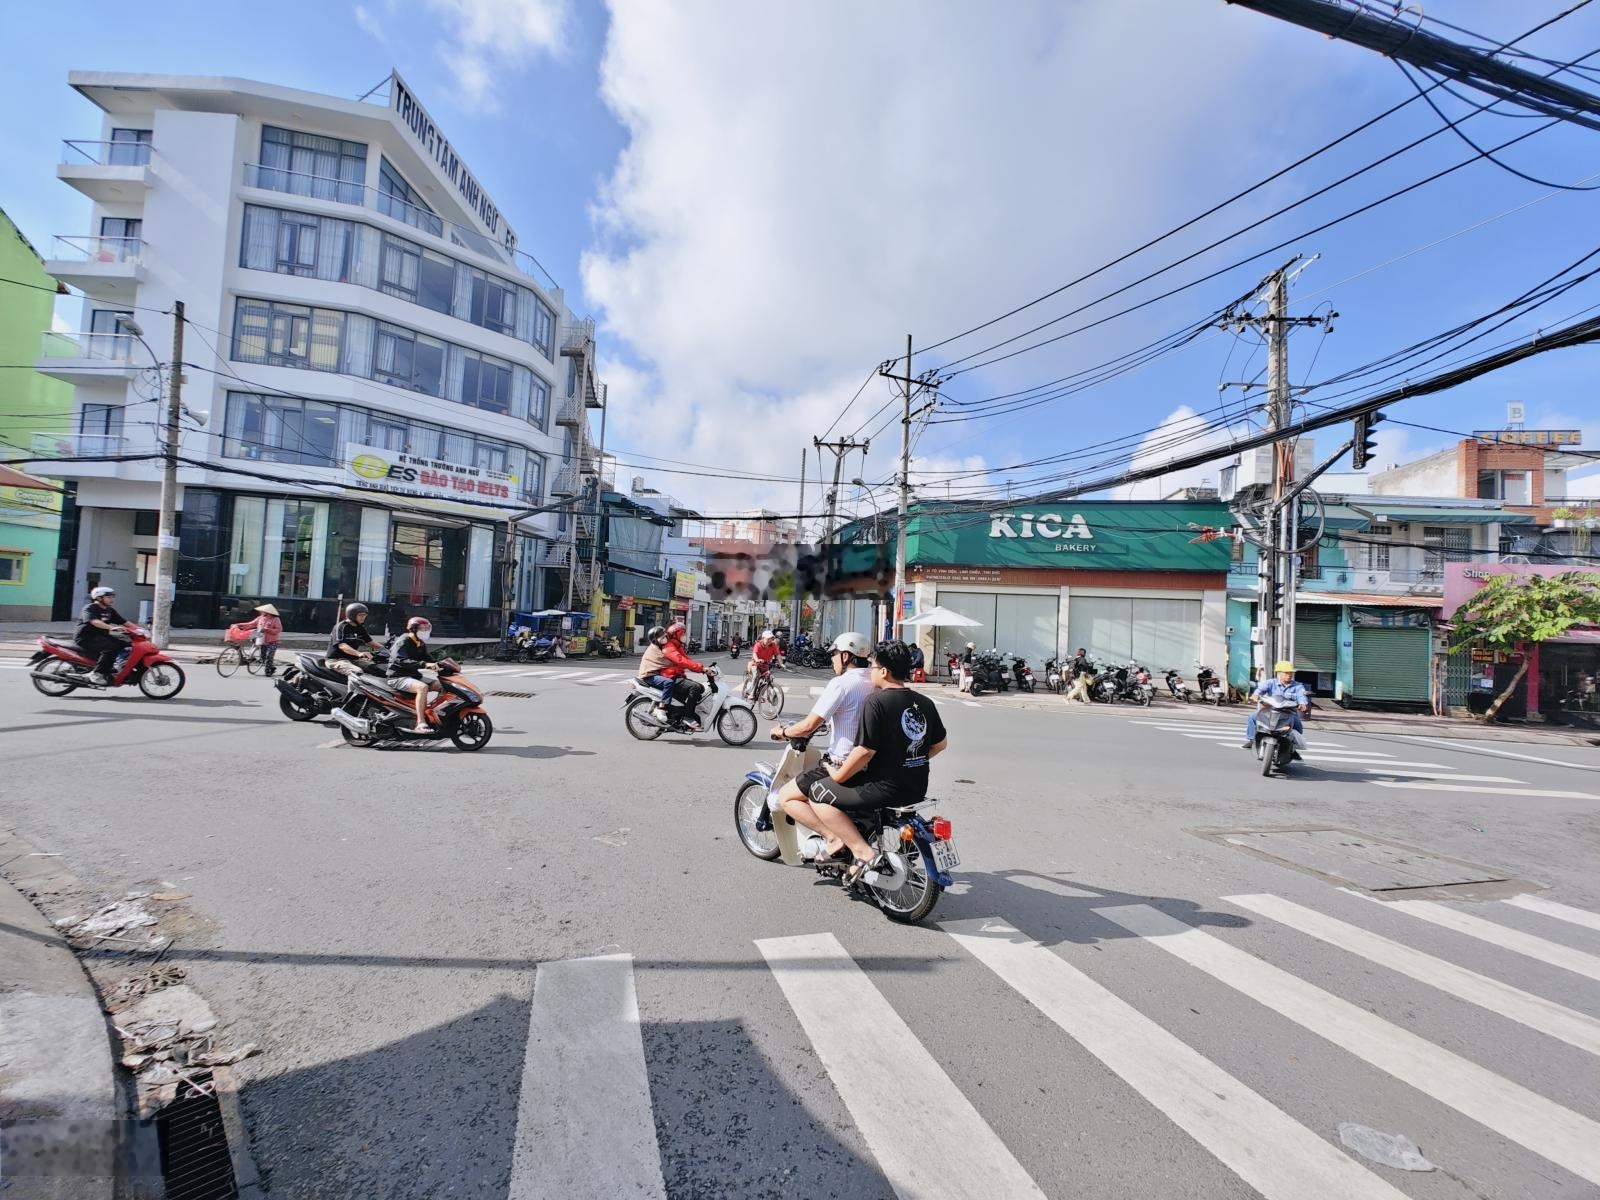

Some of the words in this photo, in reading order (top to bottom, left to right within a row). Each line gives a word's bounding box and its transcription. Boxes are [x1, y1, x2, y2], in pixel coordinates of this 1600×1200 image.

[435, 132, 459, 186] TÂM
[459, 170, 480, 211] ANH
[1511, 407, 1522, 418] B
[1481, 431, 1579, 443] COFFEE
[386, 464, 418, 482] ES
[989, 513, 1094, 538] KICA
[1055, 544, 1096, 552] BAKERY
[938, 852, 958, 869] 1053
